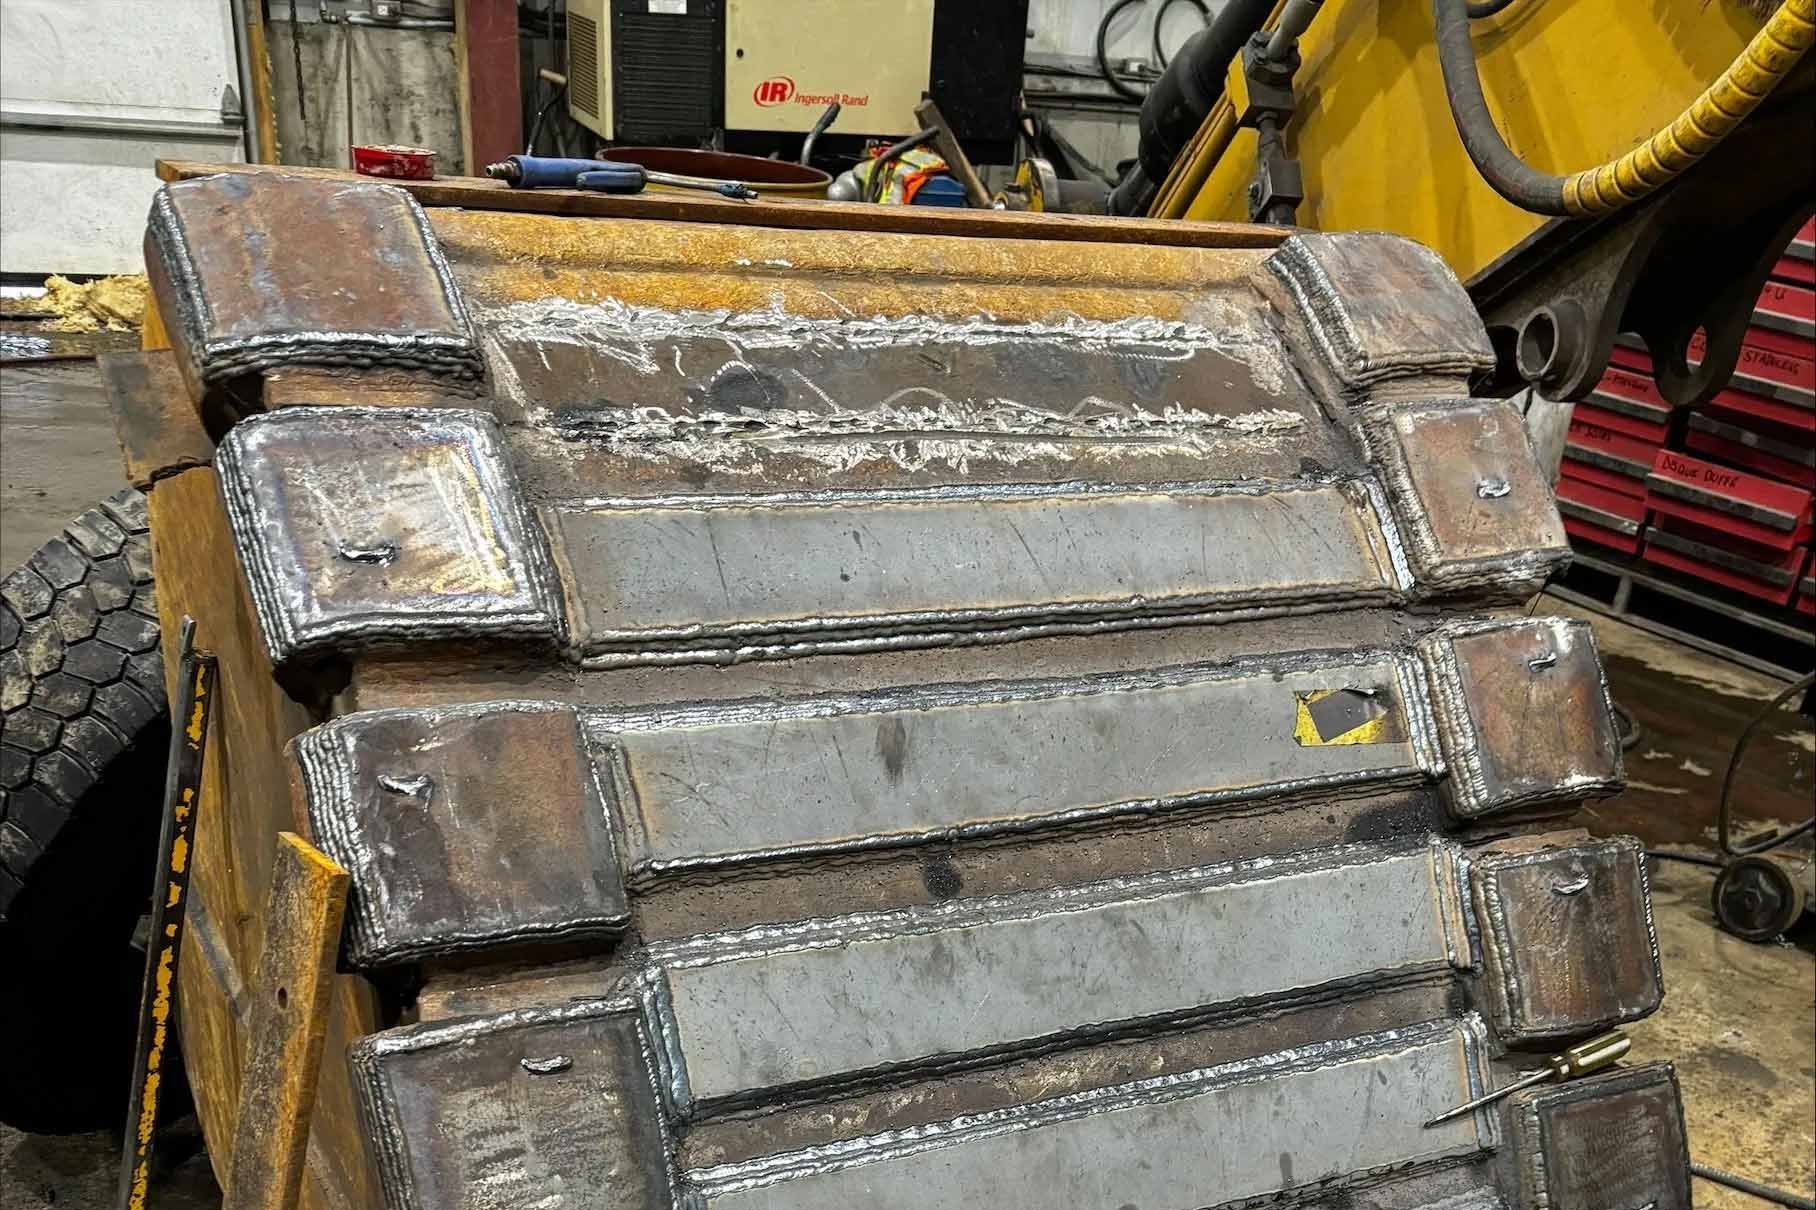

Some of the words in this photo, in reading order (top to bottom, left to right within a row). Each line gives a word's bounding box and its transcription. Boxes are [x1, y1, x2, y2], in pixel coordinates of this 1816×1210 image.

[758, 80, 789, 103] IR
[795, 94, 840, 106] Ingersoll
[841, 94, 869, 106] Rand
